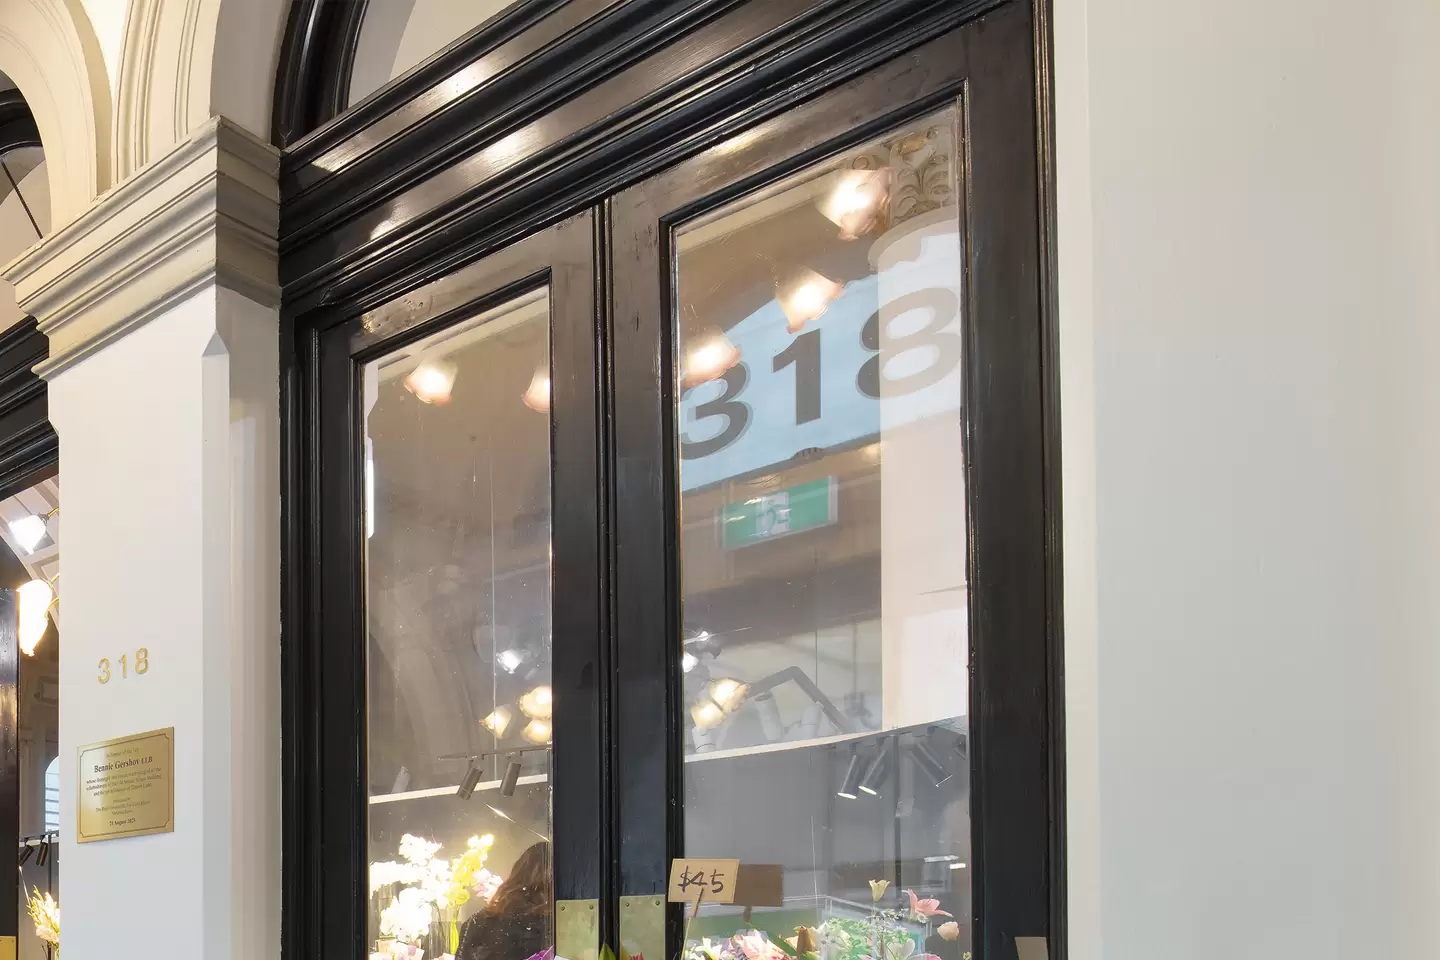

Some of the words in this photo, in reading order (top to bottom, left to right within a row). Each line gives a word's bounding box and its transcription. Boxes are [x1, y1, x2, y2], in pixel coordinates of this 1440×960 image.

[679, 287, 962, 461] 318
[97, 647, 149, 684] 318
[114, 757, 140, 770] Gershov
[677, 865, 725, 894] $45
